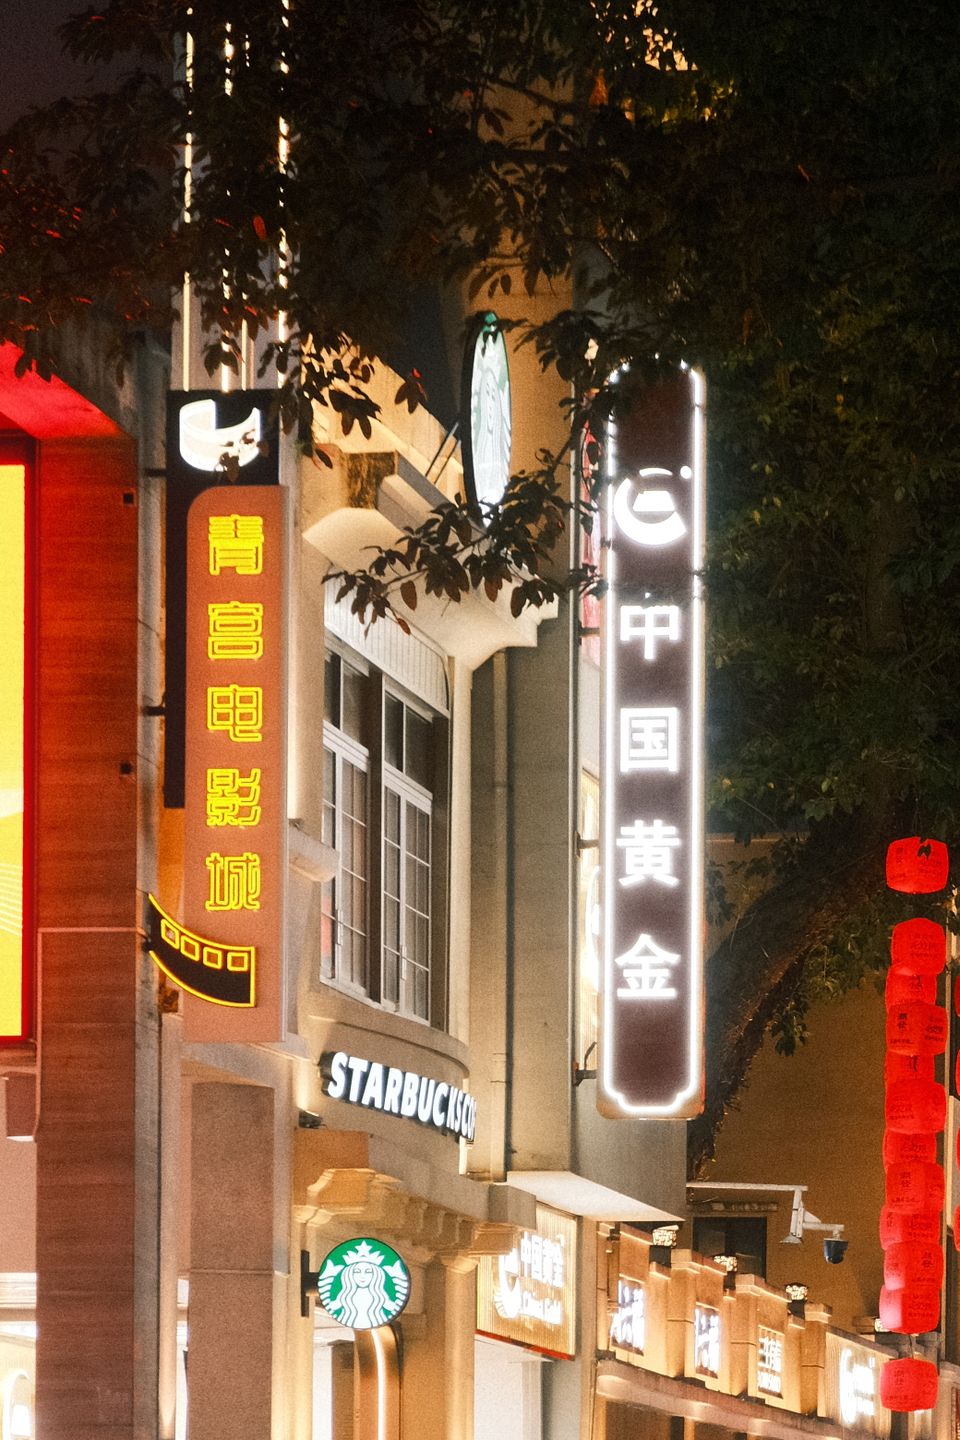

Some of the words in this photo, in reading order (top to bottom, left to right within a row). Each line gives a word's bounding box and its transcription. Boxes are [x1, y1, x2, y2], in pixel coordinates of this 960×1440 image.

[206, 514, 265, 914] 青宫电影城
[615, 594, 681, 1000] 中国黄金
[327, 1051, 463, 1134] STARBUCKS
